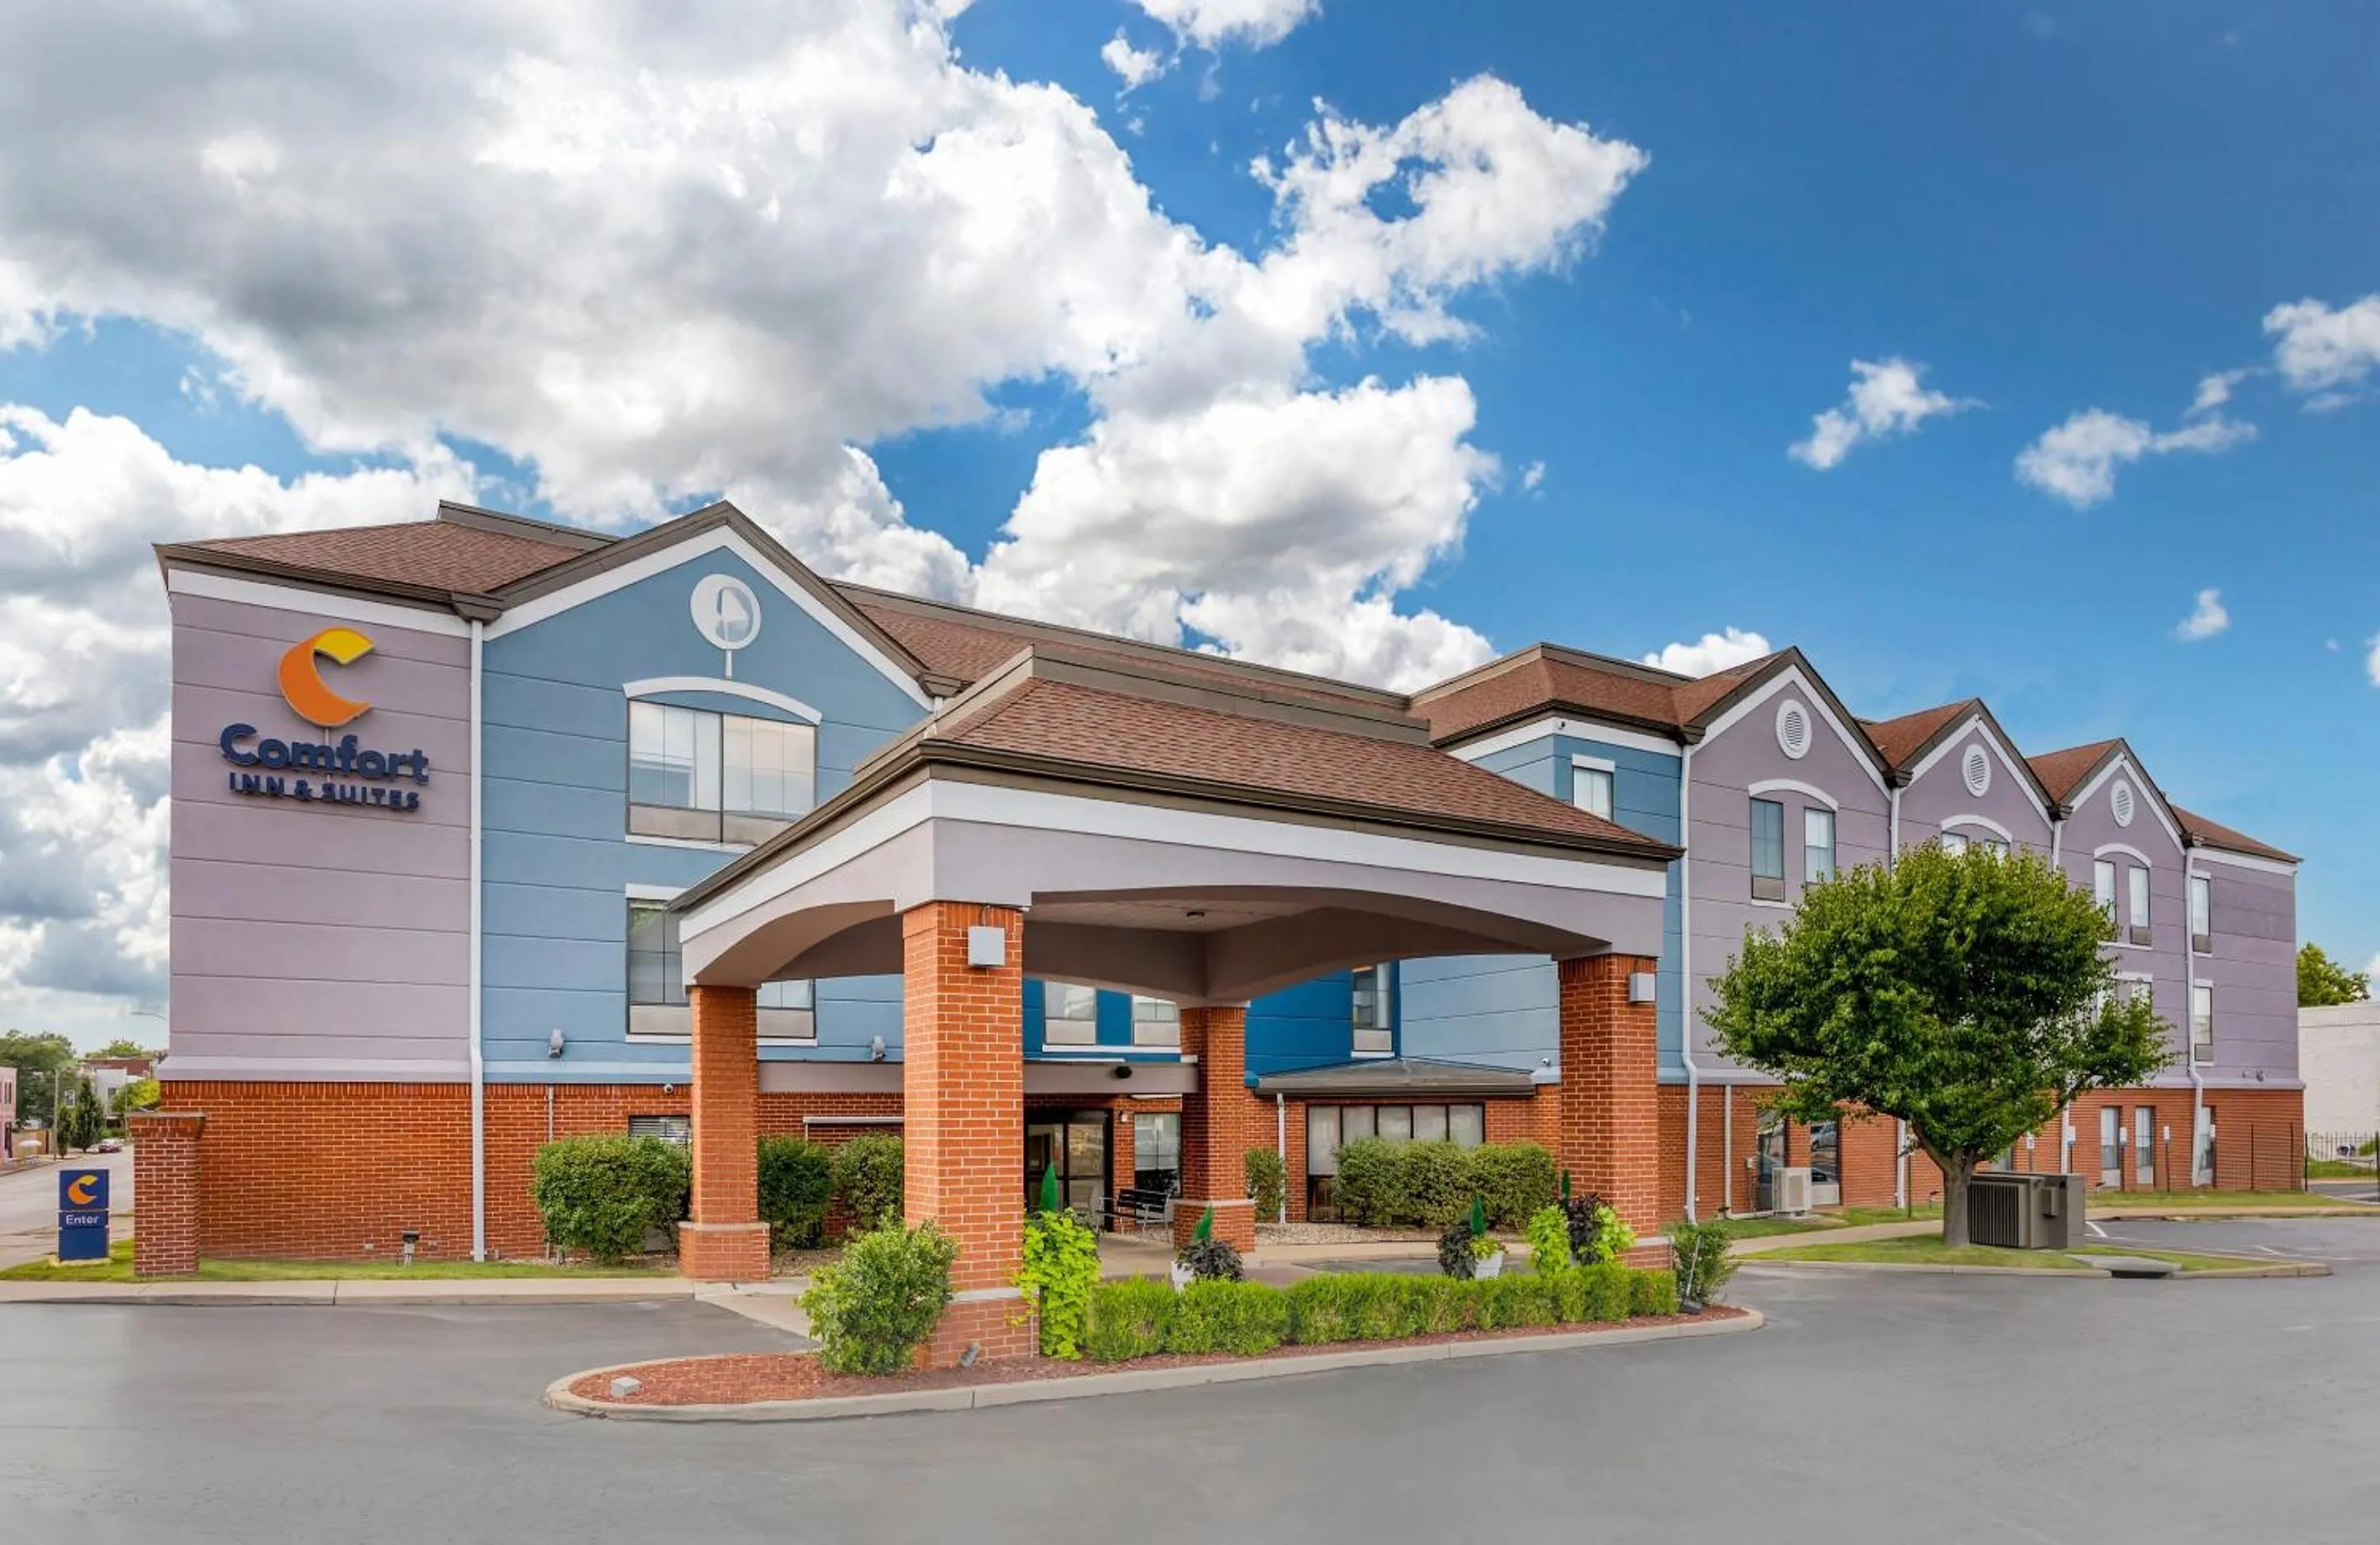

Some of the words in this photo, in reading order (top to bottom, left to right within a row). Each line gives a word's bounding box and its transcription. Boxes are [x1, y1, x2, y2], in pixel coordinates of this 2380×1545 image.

[220, 723, 429, 786] Comfort
[229, 772, 285, 796] INN
[293, 779, 312, 801] &
[321, 782, 420, 811] SUITES
[66, 1214, 100, 1225] Enter
